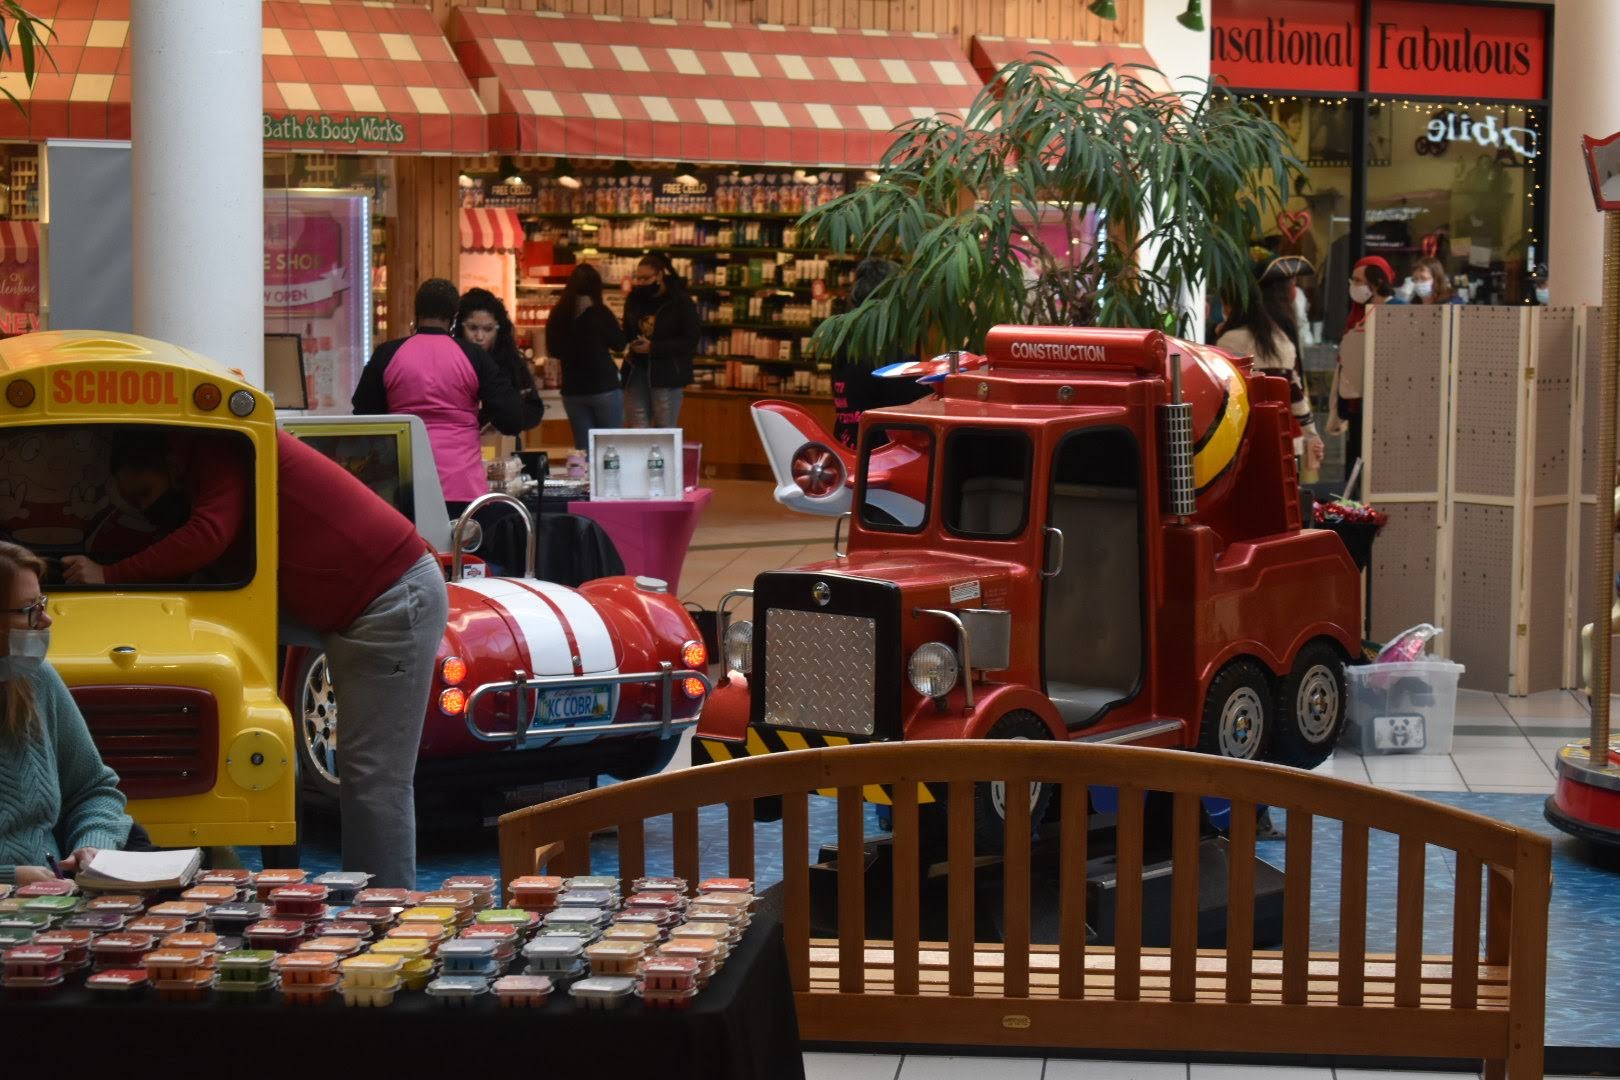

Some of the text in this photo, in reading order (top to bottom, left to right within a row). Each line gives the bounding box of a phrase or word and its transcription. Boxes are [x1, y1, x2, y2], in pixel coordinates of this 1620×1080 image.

[1376, 22, 1531, 76] Fabulous
[263, 114, 404, 144] Bath & Body Works
[491, 185, 509, 195] FREE
[662, 183, 681, 194] FREE
[275, 254, 323, 270] SHOP
[274, 289, 308, 302] OPEN
[1011, 342, 1106, 361] CONSTRUCTION
[53, 369, 178, 405] SCHOOL
[548, 695, 599, 718] KC COBRA
